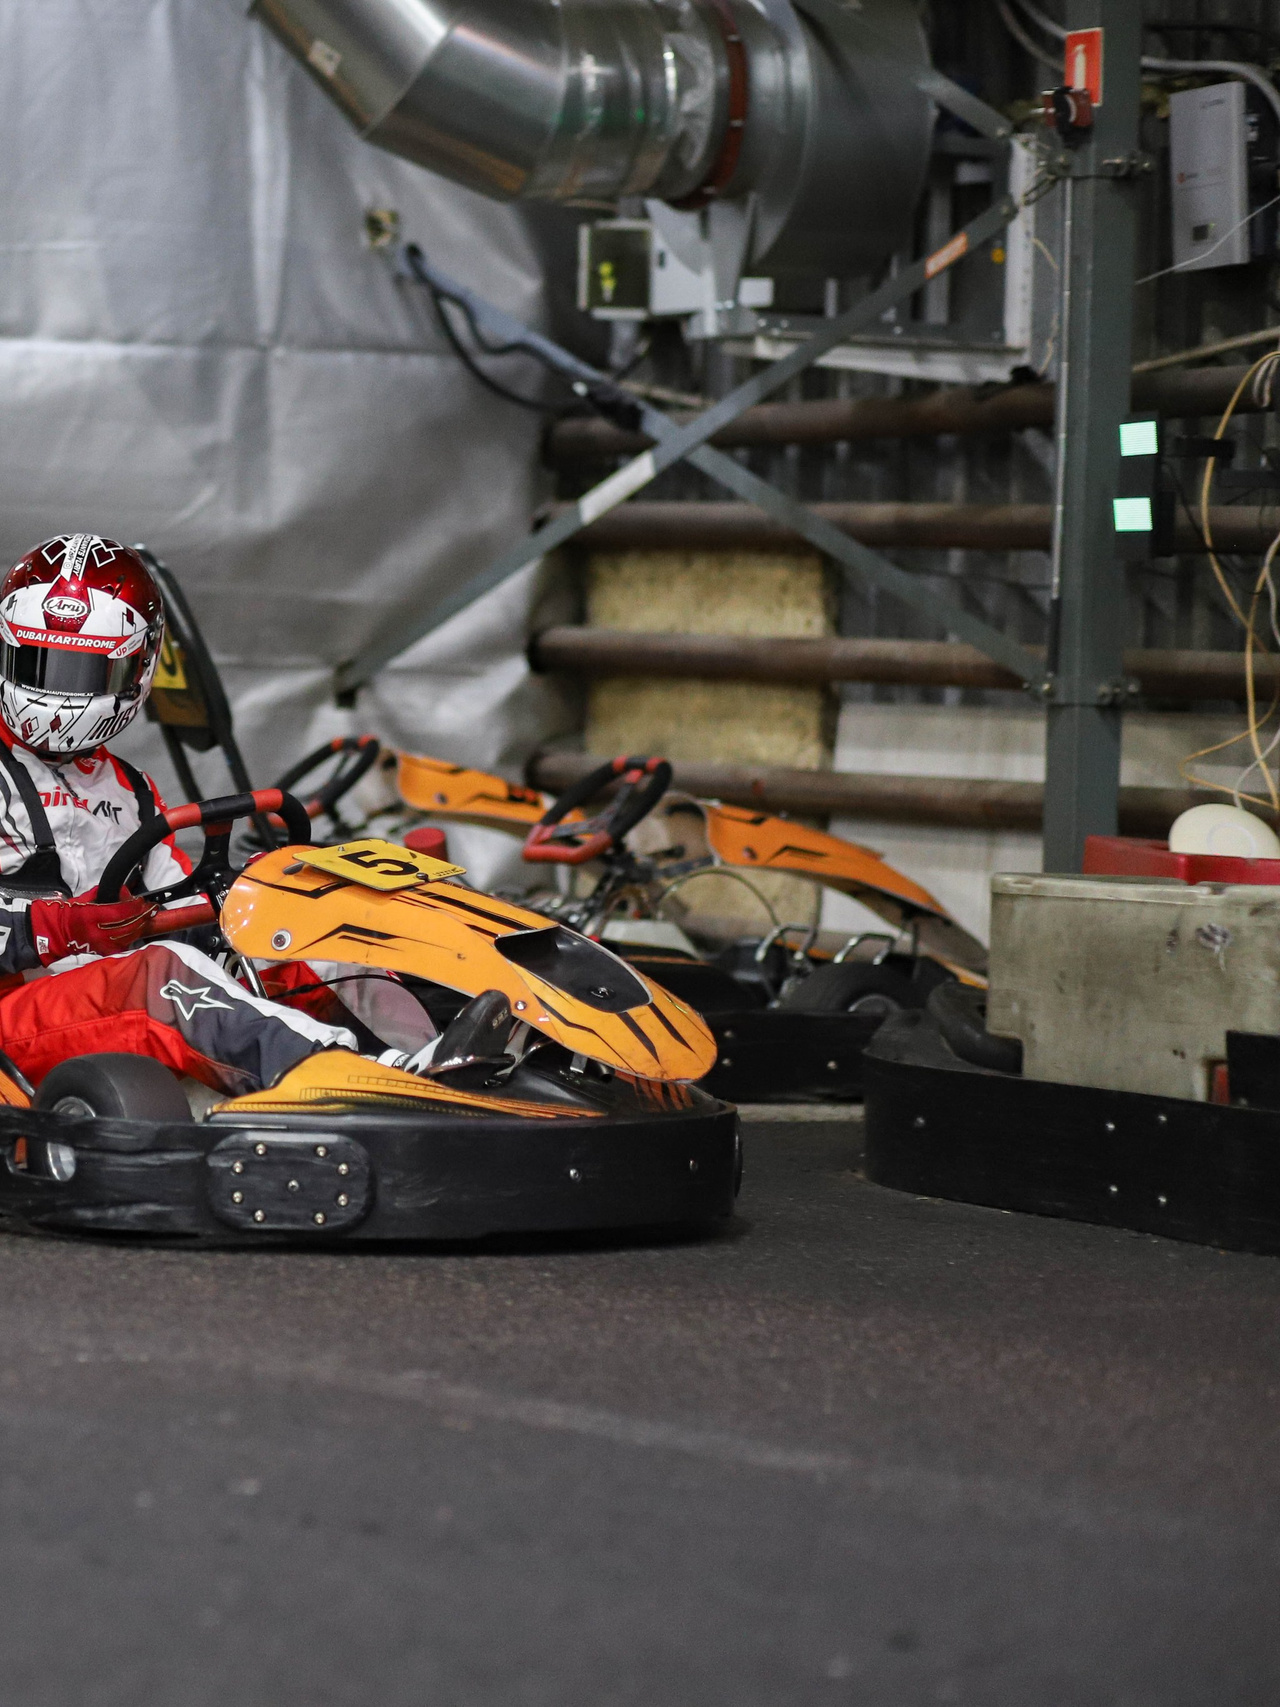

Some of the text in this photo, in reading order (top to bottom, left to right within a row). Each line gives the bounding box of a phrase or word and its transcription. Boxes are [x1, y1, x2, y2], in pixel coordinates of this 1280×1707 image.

[16, 629, 46, 642] DUBAI
[47, 634, 117, 649] KARTDROME
[338, 849, 420, 876] 5
